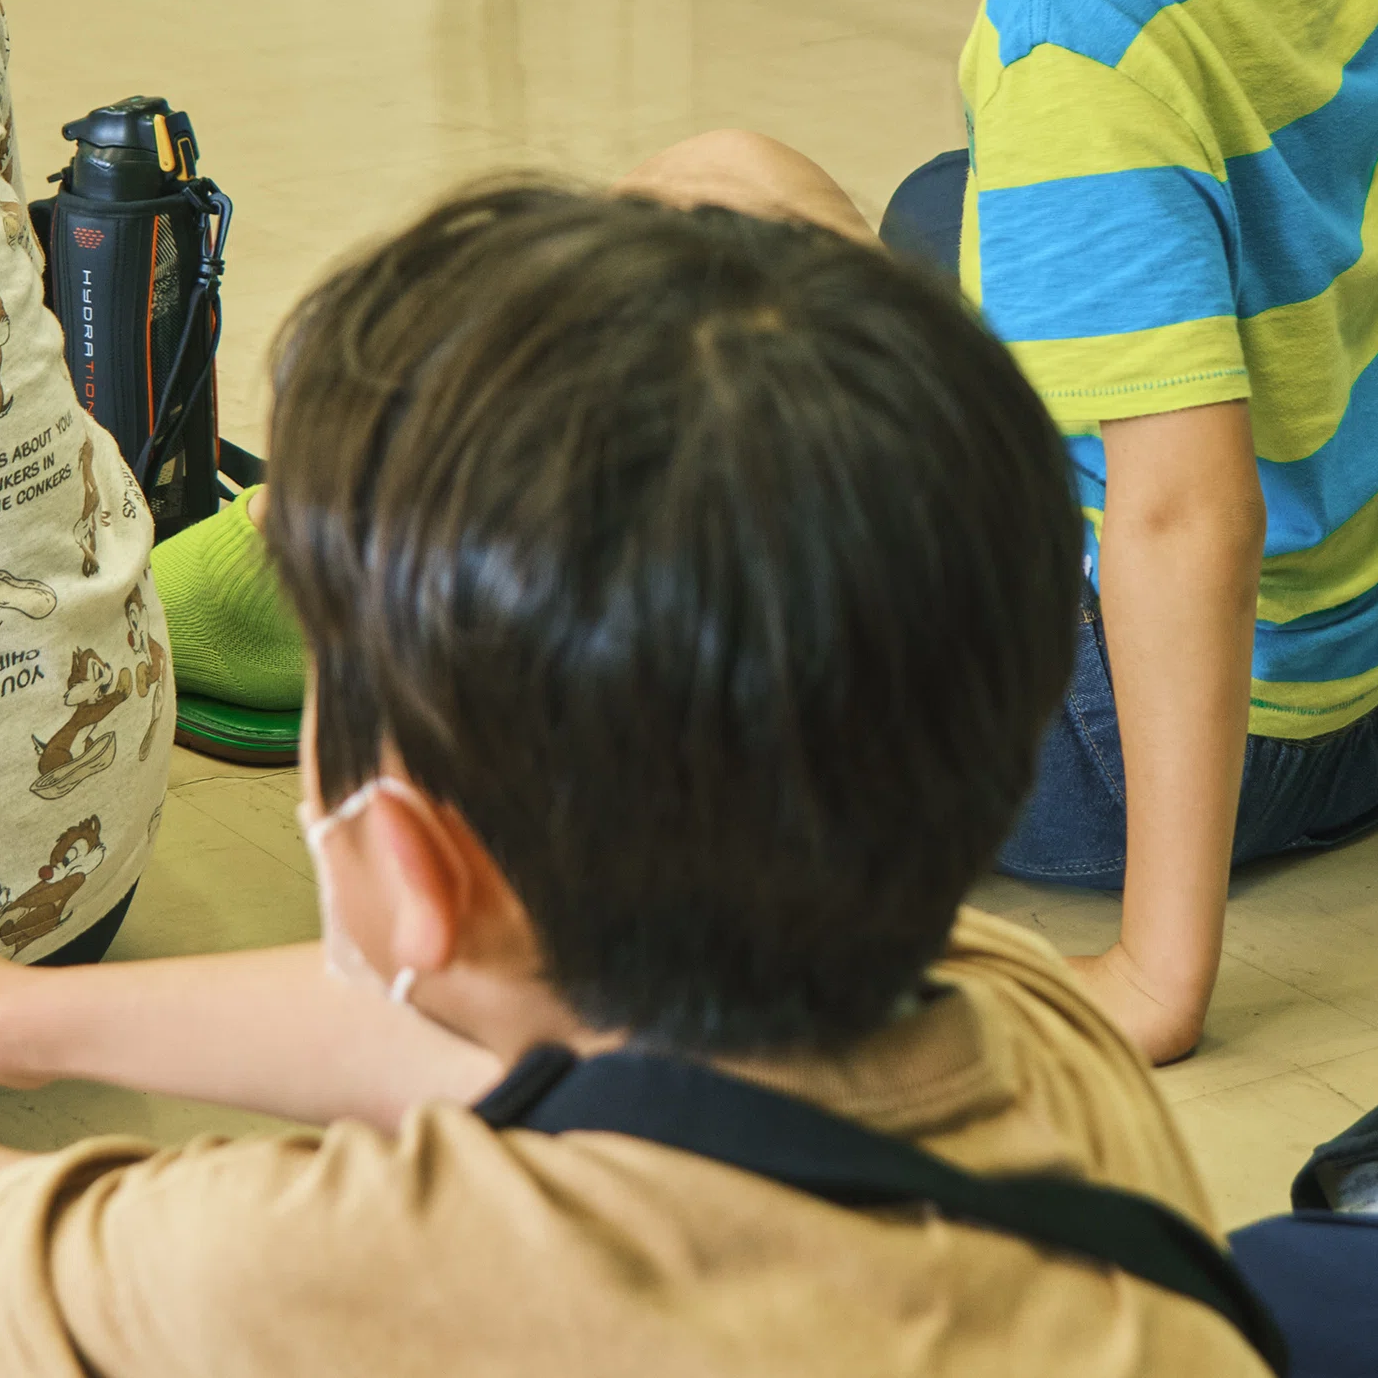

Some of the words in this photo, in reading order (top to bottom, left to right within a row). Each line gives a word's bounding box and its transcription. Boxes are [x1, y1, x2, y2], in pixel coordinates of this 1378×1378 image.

[82, 269, 95, 417] HYDRATION
[12, 427, 52, 463] ABOUT
[43, 452, 55, 470] IN
[16, 463, 72, 505] CONKERS
